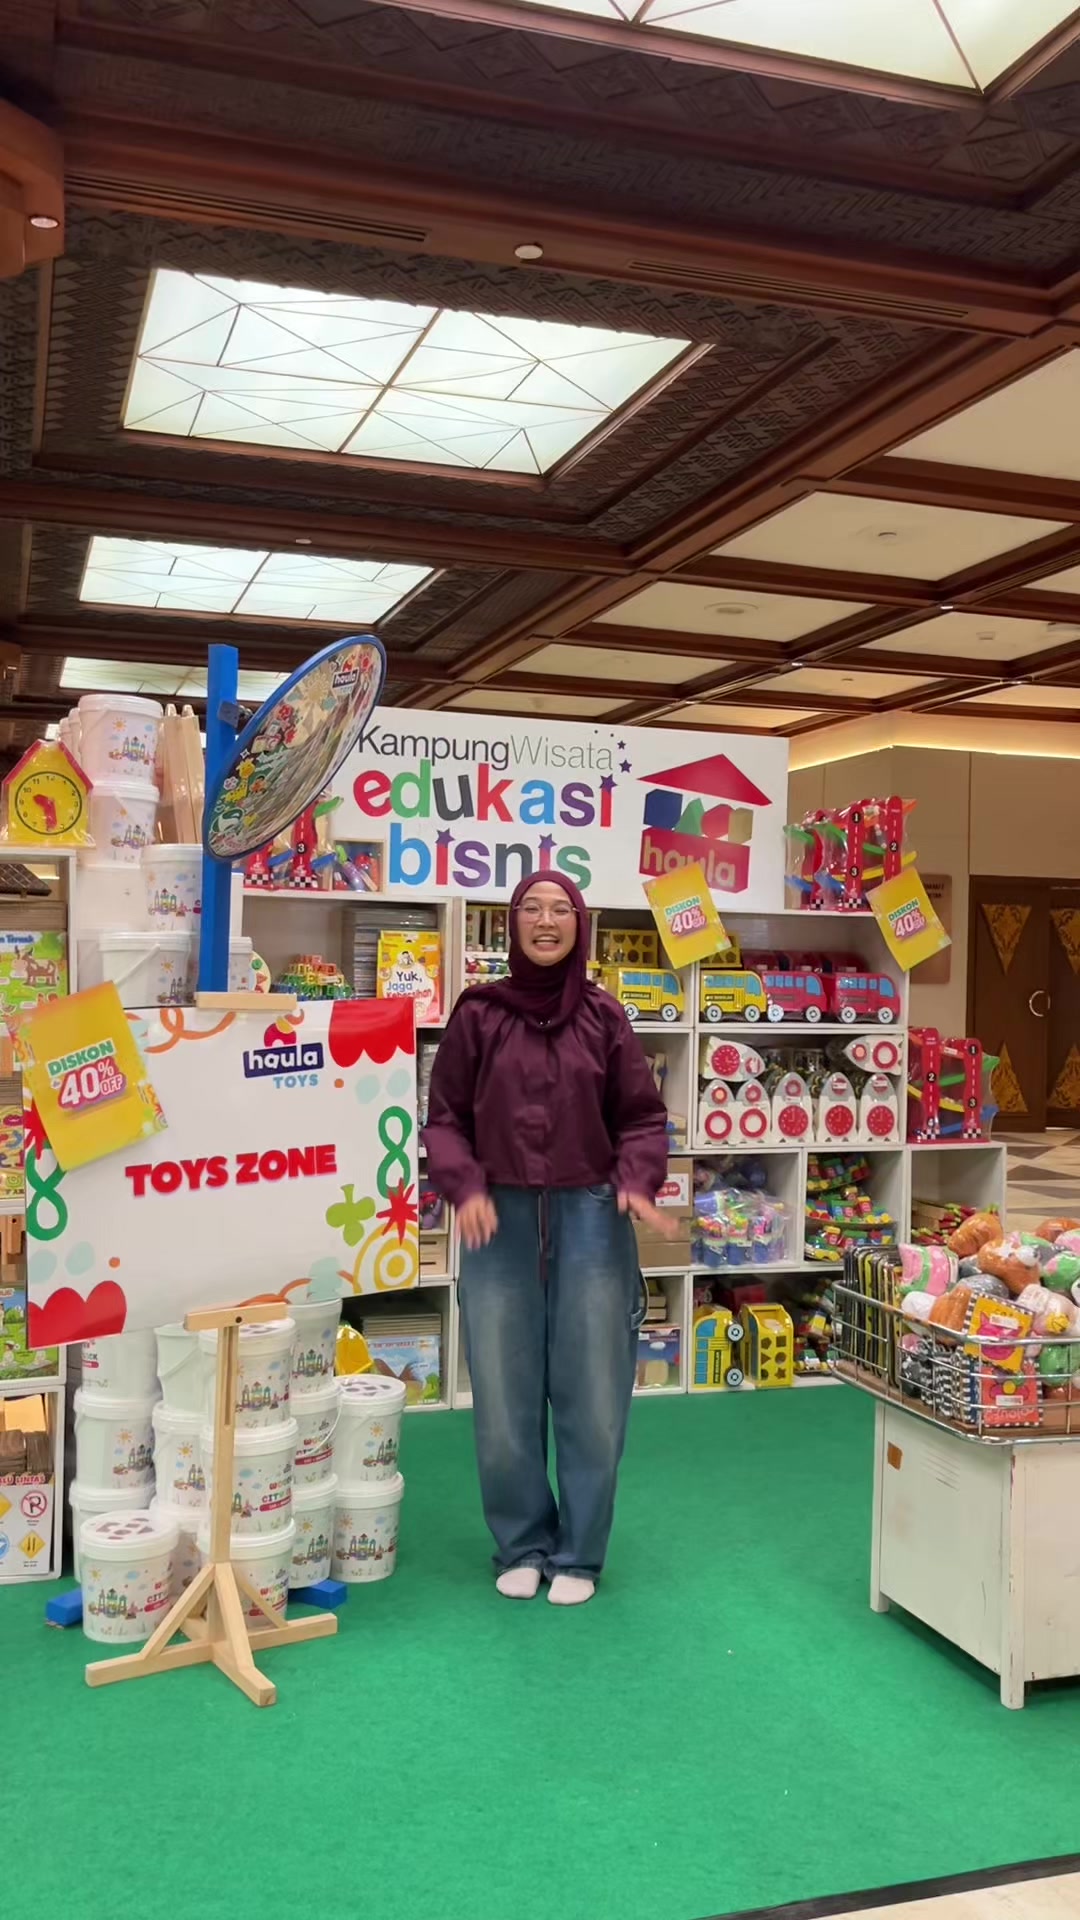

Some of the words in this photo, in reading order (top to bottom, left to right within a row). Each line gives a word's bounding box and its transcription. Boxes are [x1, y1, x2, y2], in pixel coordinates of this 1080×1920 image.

[353, 758, 618, 828] edukasi
[298, 843, 305, 852] 3
[389, 822, 592, 891] bisnis
[891, 842, 897, 850] 2
[851, 867, 857, 876] 3
[665, 895, 700, 916] DISKON
[888, 898, 919, 921] DISKON
[672, 907, 700, 933] 40%
[895, 909, 920, 937] 40%
[396, 970, 423, 982] Yuk,
[386, 982, 413, 992] Jaga
[47, 1040, 114, 1077] DISKON
[249, 1043, 319, 1070] haula
[61, 1058, 114, 1105] 40%
[101, 1074, 123, 1095] OFF
[272, 1073, 320, 1089] TOYS
[928, 1073, 935, 1082] 2
[970, 1099, 976, 1107] 3
[125, 1155, 230, 1198] TOYS
[235, 1144, 338, 1186] ZONE
[17, 1474, 46, 1485] LINTAS
